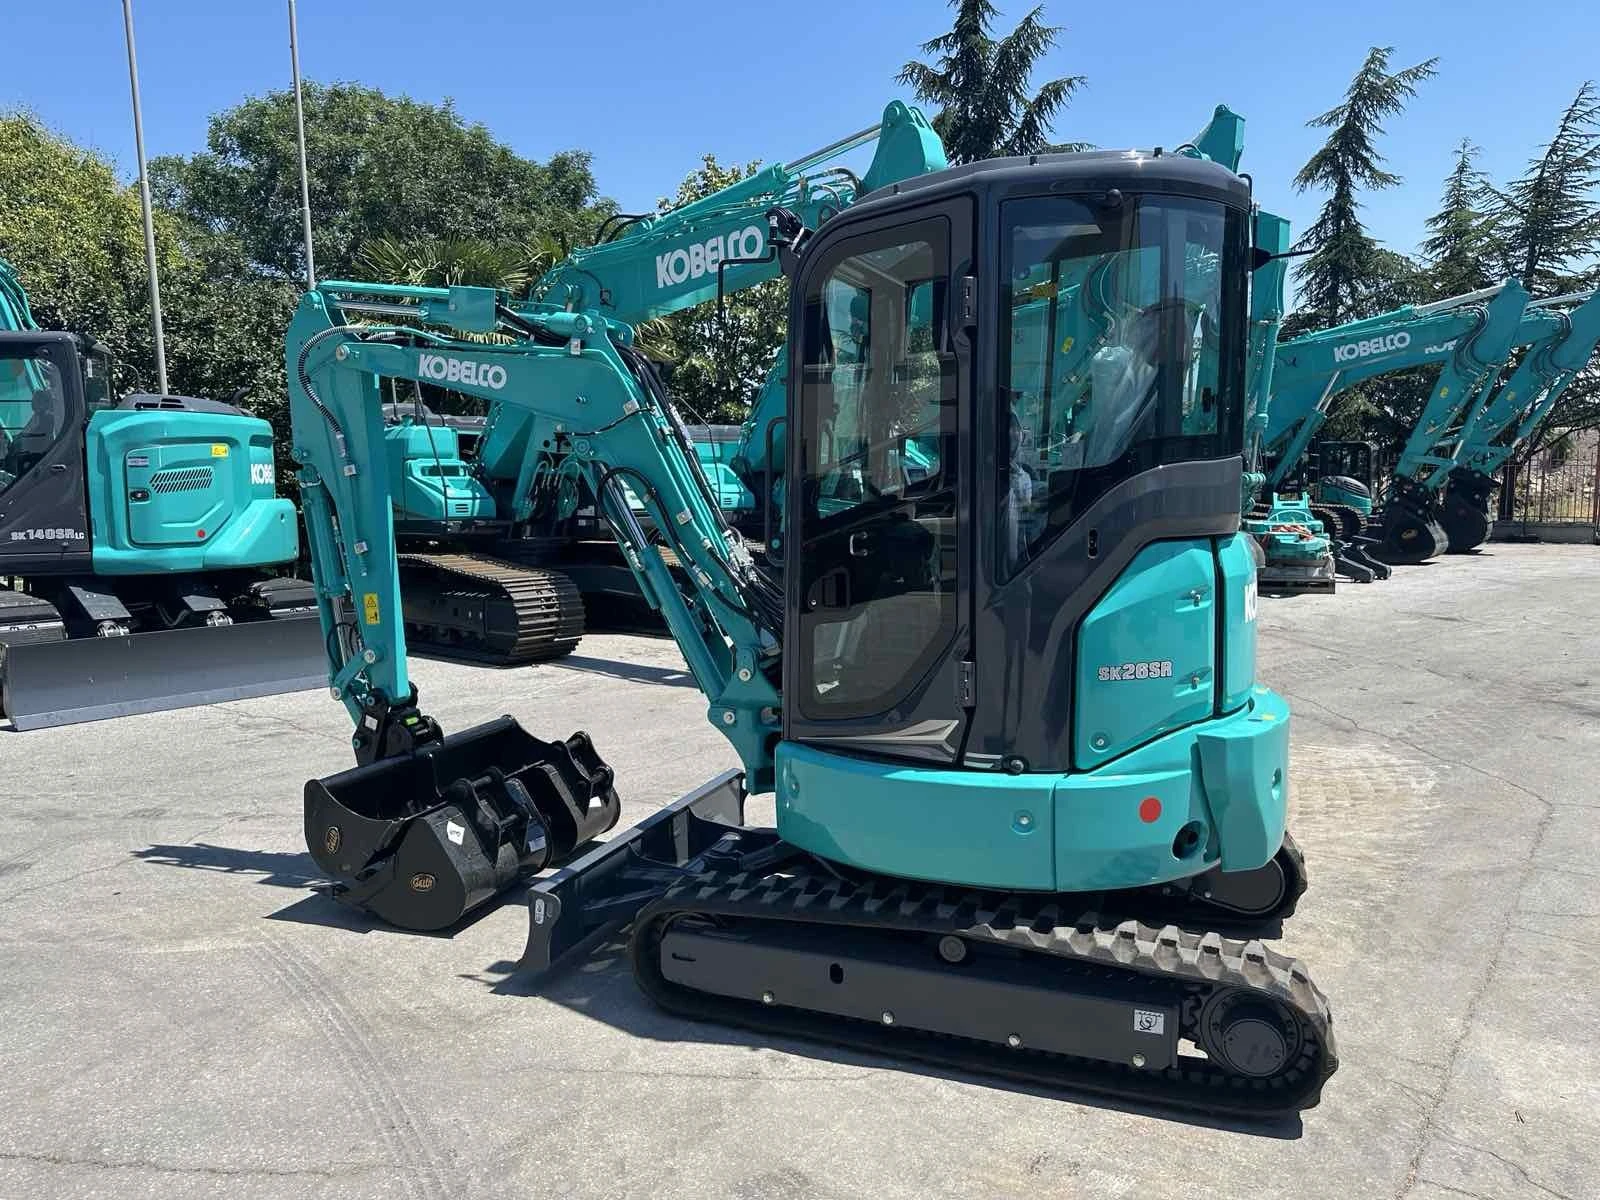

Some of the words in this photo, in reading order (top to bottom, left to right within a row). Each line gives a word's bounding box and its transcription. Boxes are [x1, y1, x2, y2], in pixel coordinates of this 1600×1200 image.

[656, 225, 763, 289] KOBELCO
[1334, 332, 1411, 362] KOBELCO
[419, 354, 507, 390] KOBELCO
